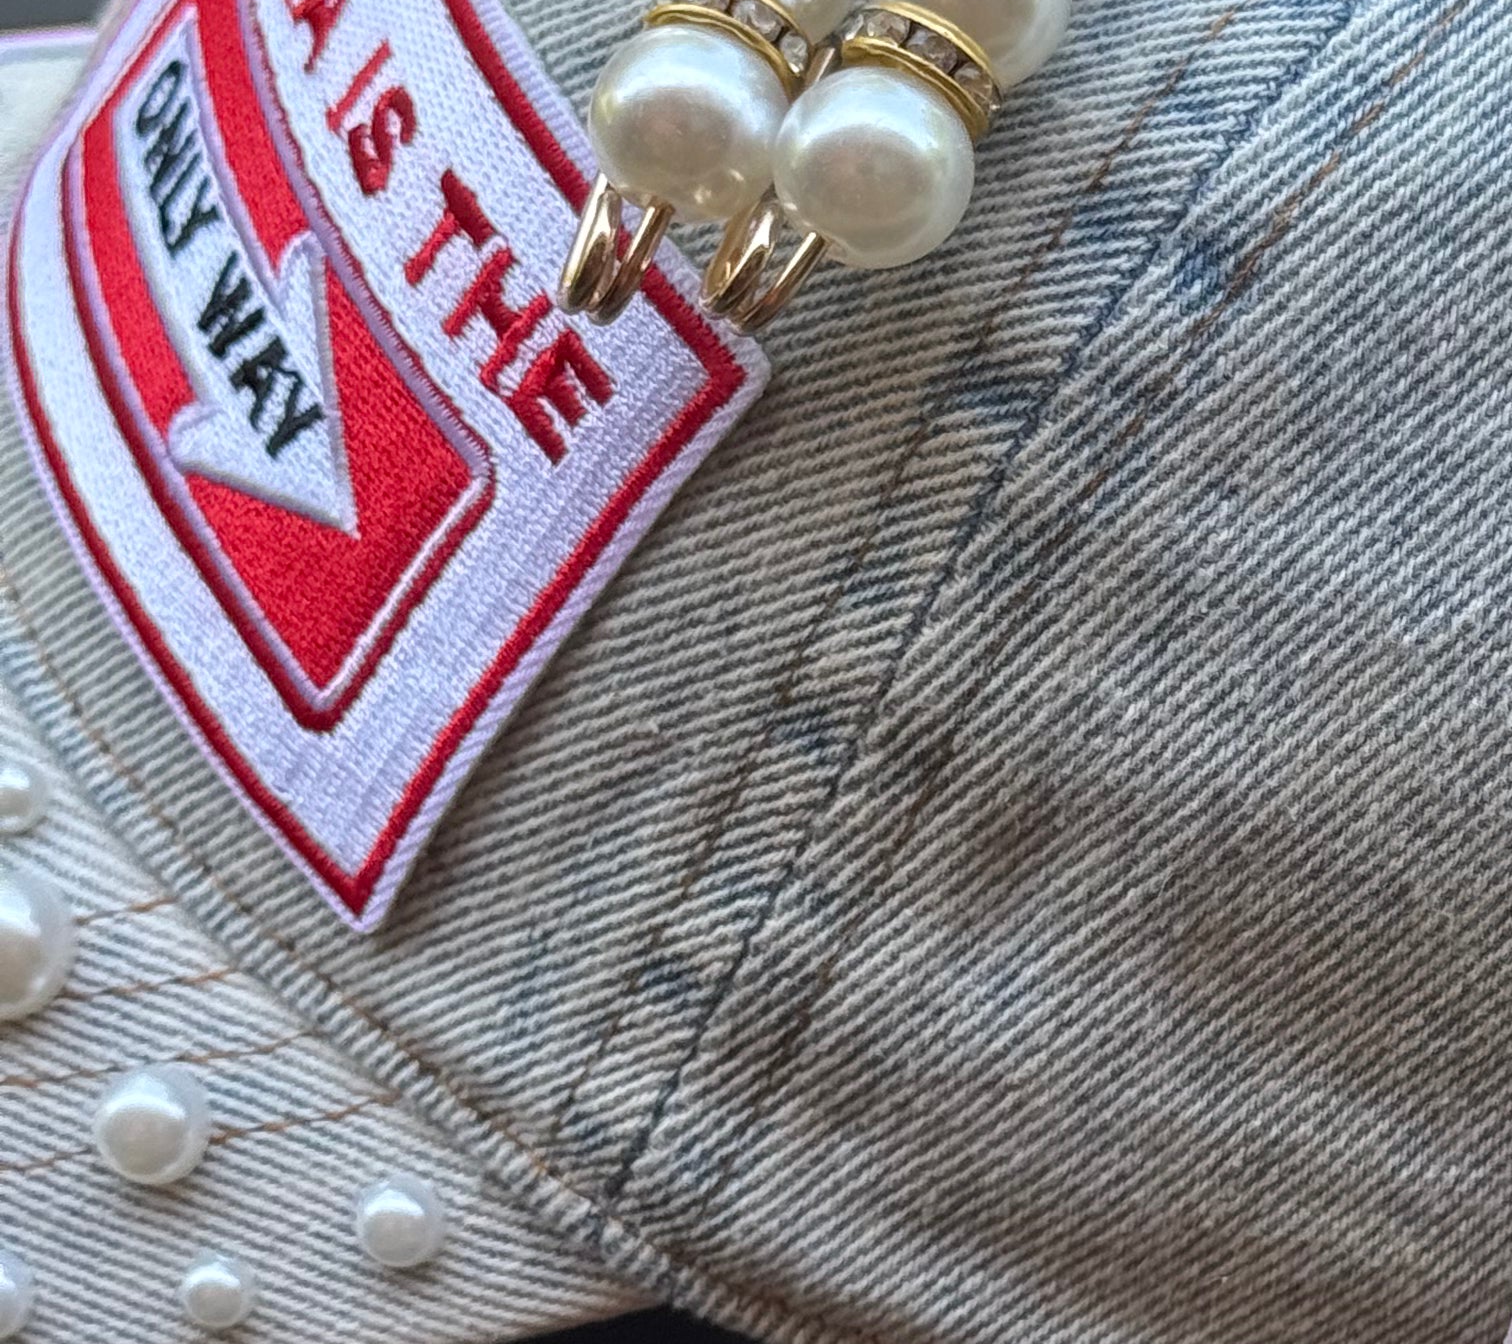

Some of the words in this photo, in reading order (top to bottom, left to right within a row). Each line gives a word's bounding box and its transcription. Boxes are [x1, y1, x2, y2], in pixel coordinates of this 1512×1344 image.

[136, 60, 221, 256] ONLY
[199, 251, 326, 458] WAY
[326, 40, 417, 195] IS
[405, 170, 615, 465] THE
